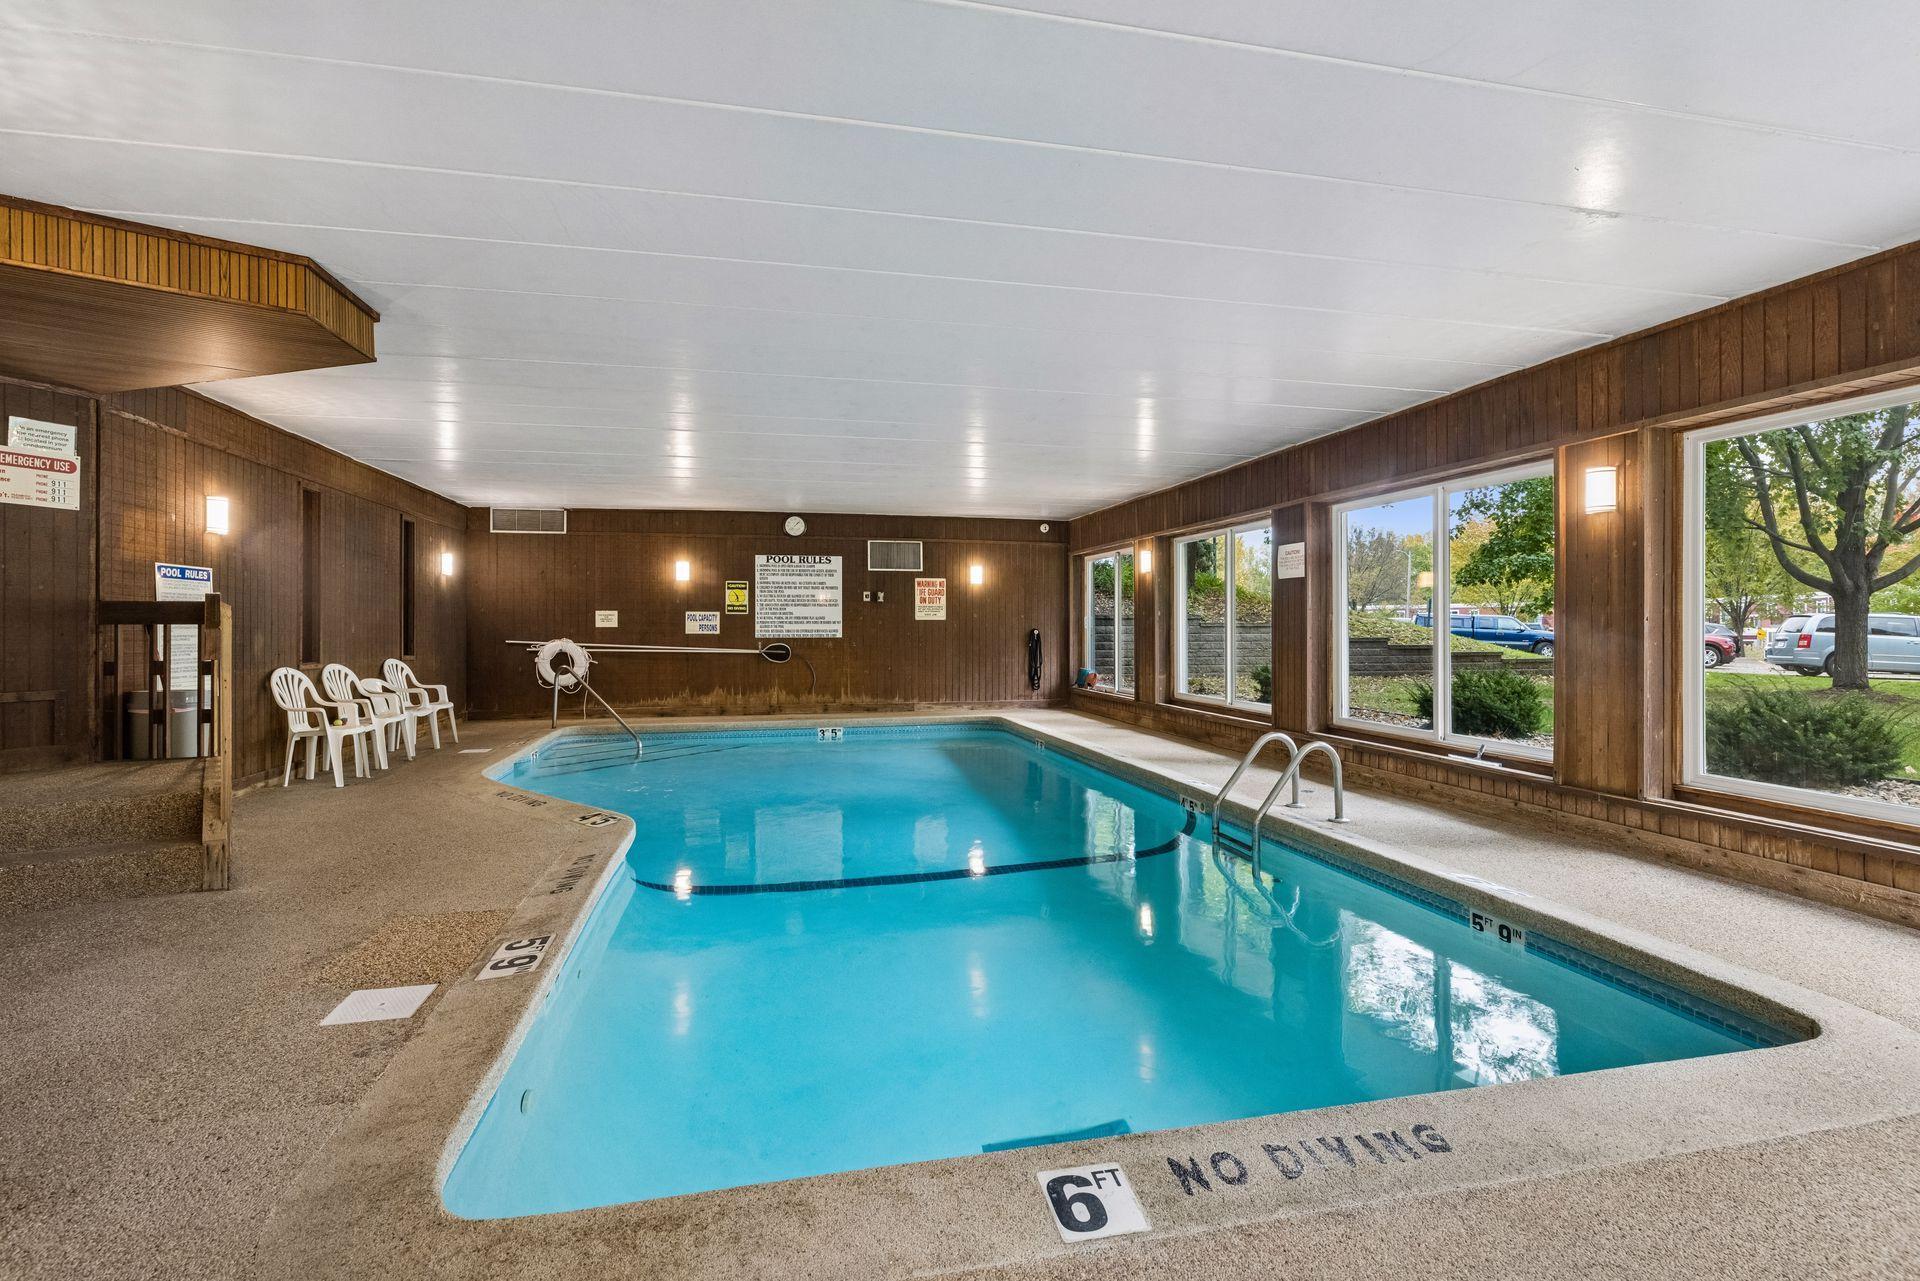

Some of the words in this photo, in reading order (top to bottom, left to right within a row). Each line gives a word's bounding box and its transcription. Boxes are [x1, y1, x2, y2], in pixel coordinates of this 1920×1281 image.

[28, 432, 50, 440] nearest
[35, 428, 68, 437] emergency
[25, 436, 47, 444] located
[0, 452, 51, 469] EMERGENCY
[54, 460, 71, 472] USE
[766, 555, 795, 564] POOL
[799, 556, 832, 565] RULES
[160, 567, 182, 578] POOL
[184, 569, 208, 580] RULES
[916, 580, 938, 588] WARNING
[927, 588, 945, 597] GUARD
[919, 596, 927, 604] ON
[927, 596, 941, 604] DUTY
[687, 613, 698, 622] POOL
[698, 613, 718, 622] CAPACITY
[698, 623, 718, 632] PERSONS
[1166, 1151, 1250, 1196] NO
[1261, 1123, 1453, 1180] DIVING
